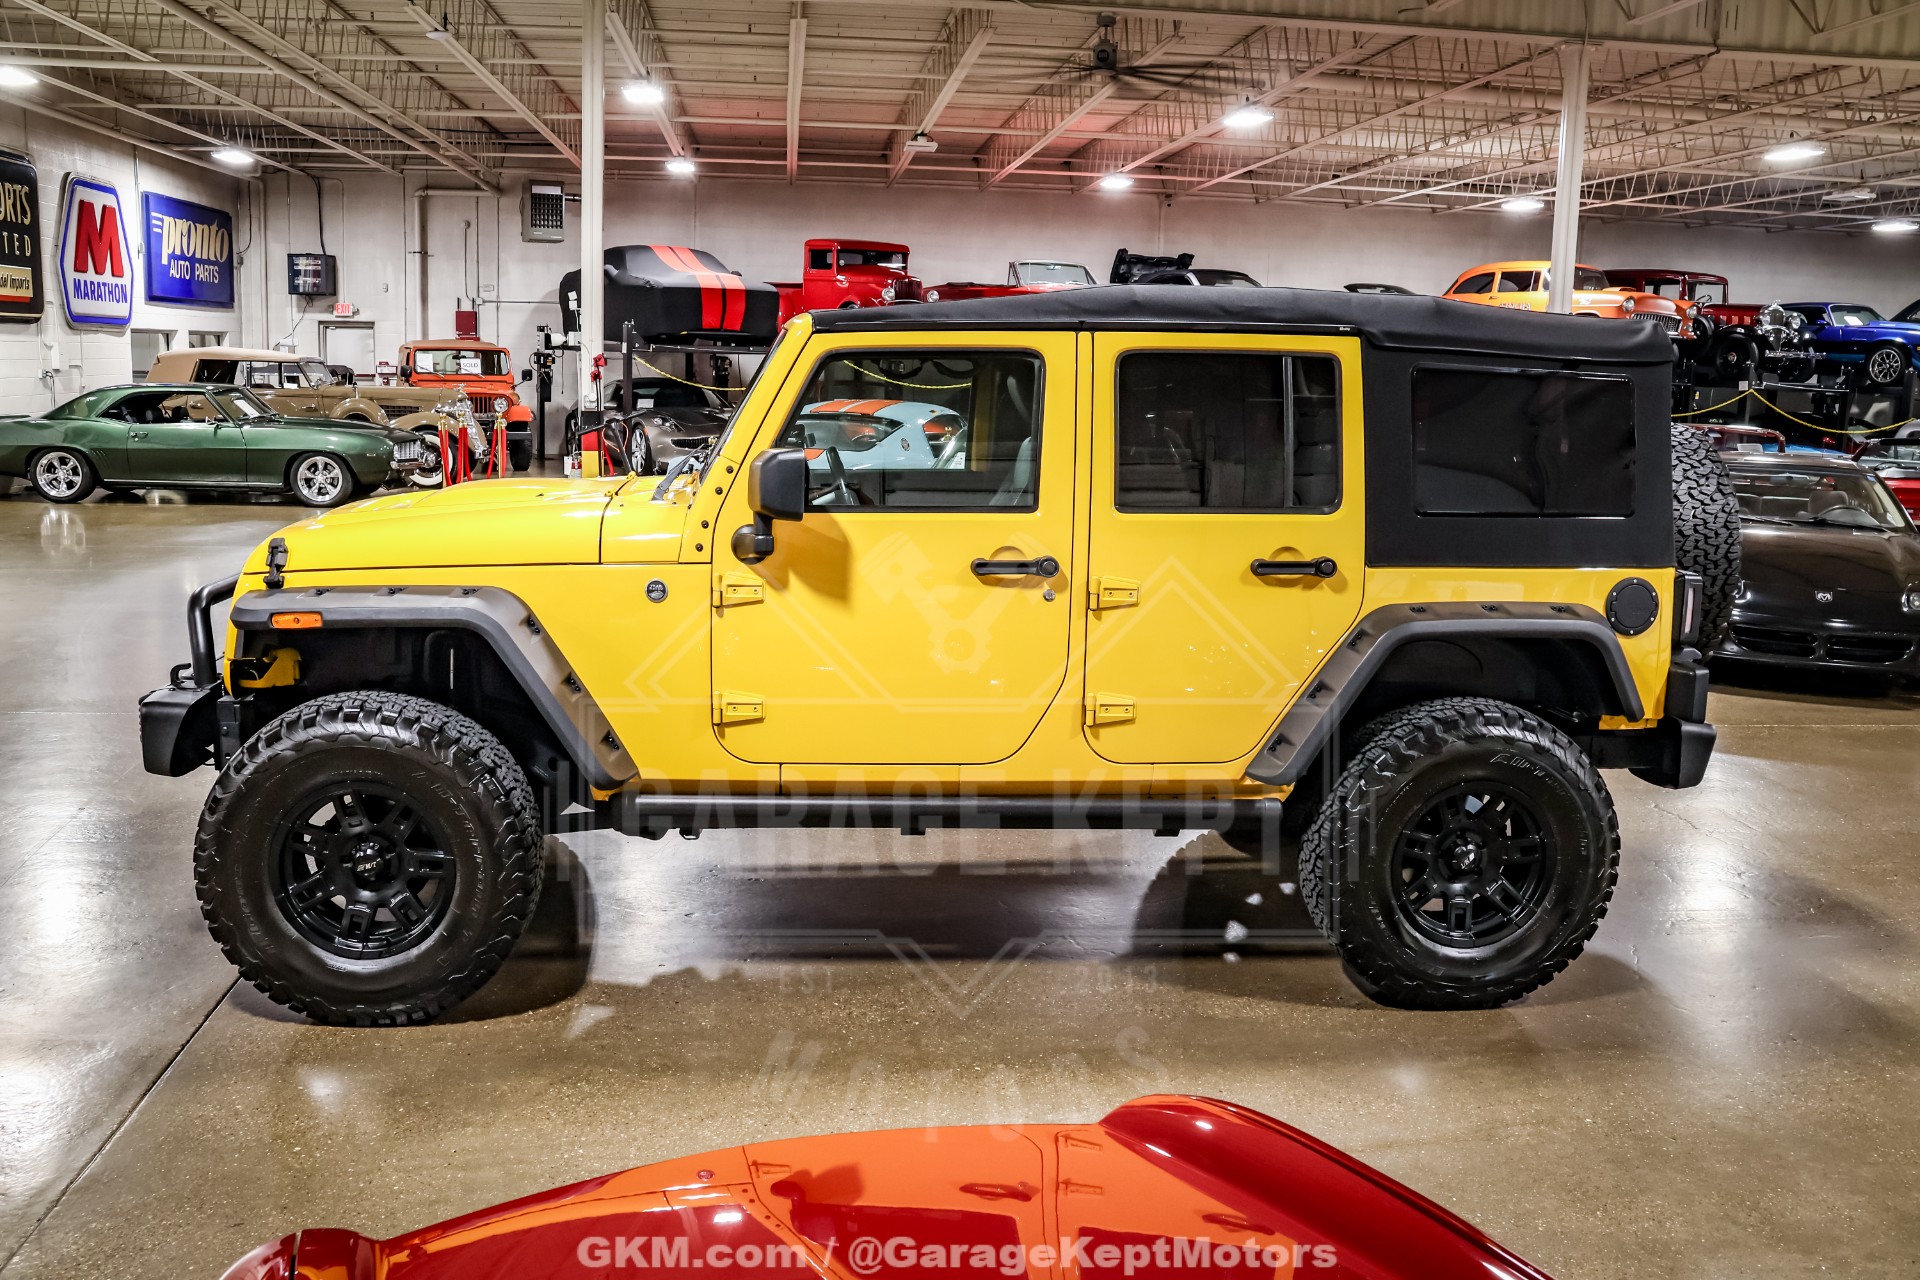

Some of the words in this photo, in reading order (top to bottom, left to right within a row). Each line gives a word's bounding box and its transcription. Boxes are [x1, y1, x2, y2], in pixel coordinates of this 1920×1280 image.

[74, 199, 124, 278] M
[161, 215, 229, 265] pronto
[169, 259, 191, 280] AUTO
[195, 263, 219, 284] PARTS
[73, 277, 128, 304] MARATHON
[335, 303, 350, 315] EXIT
